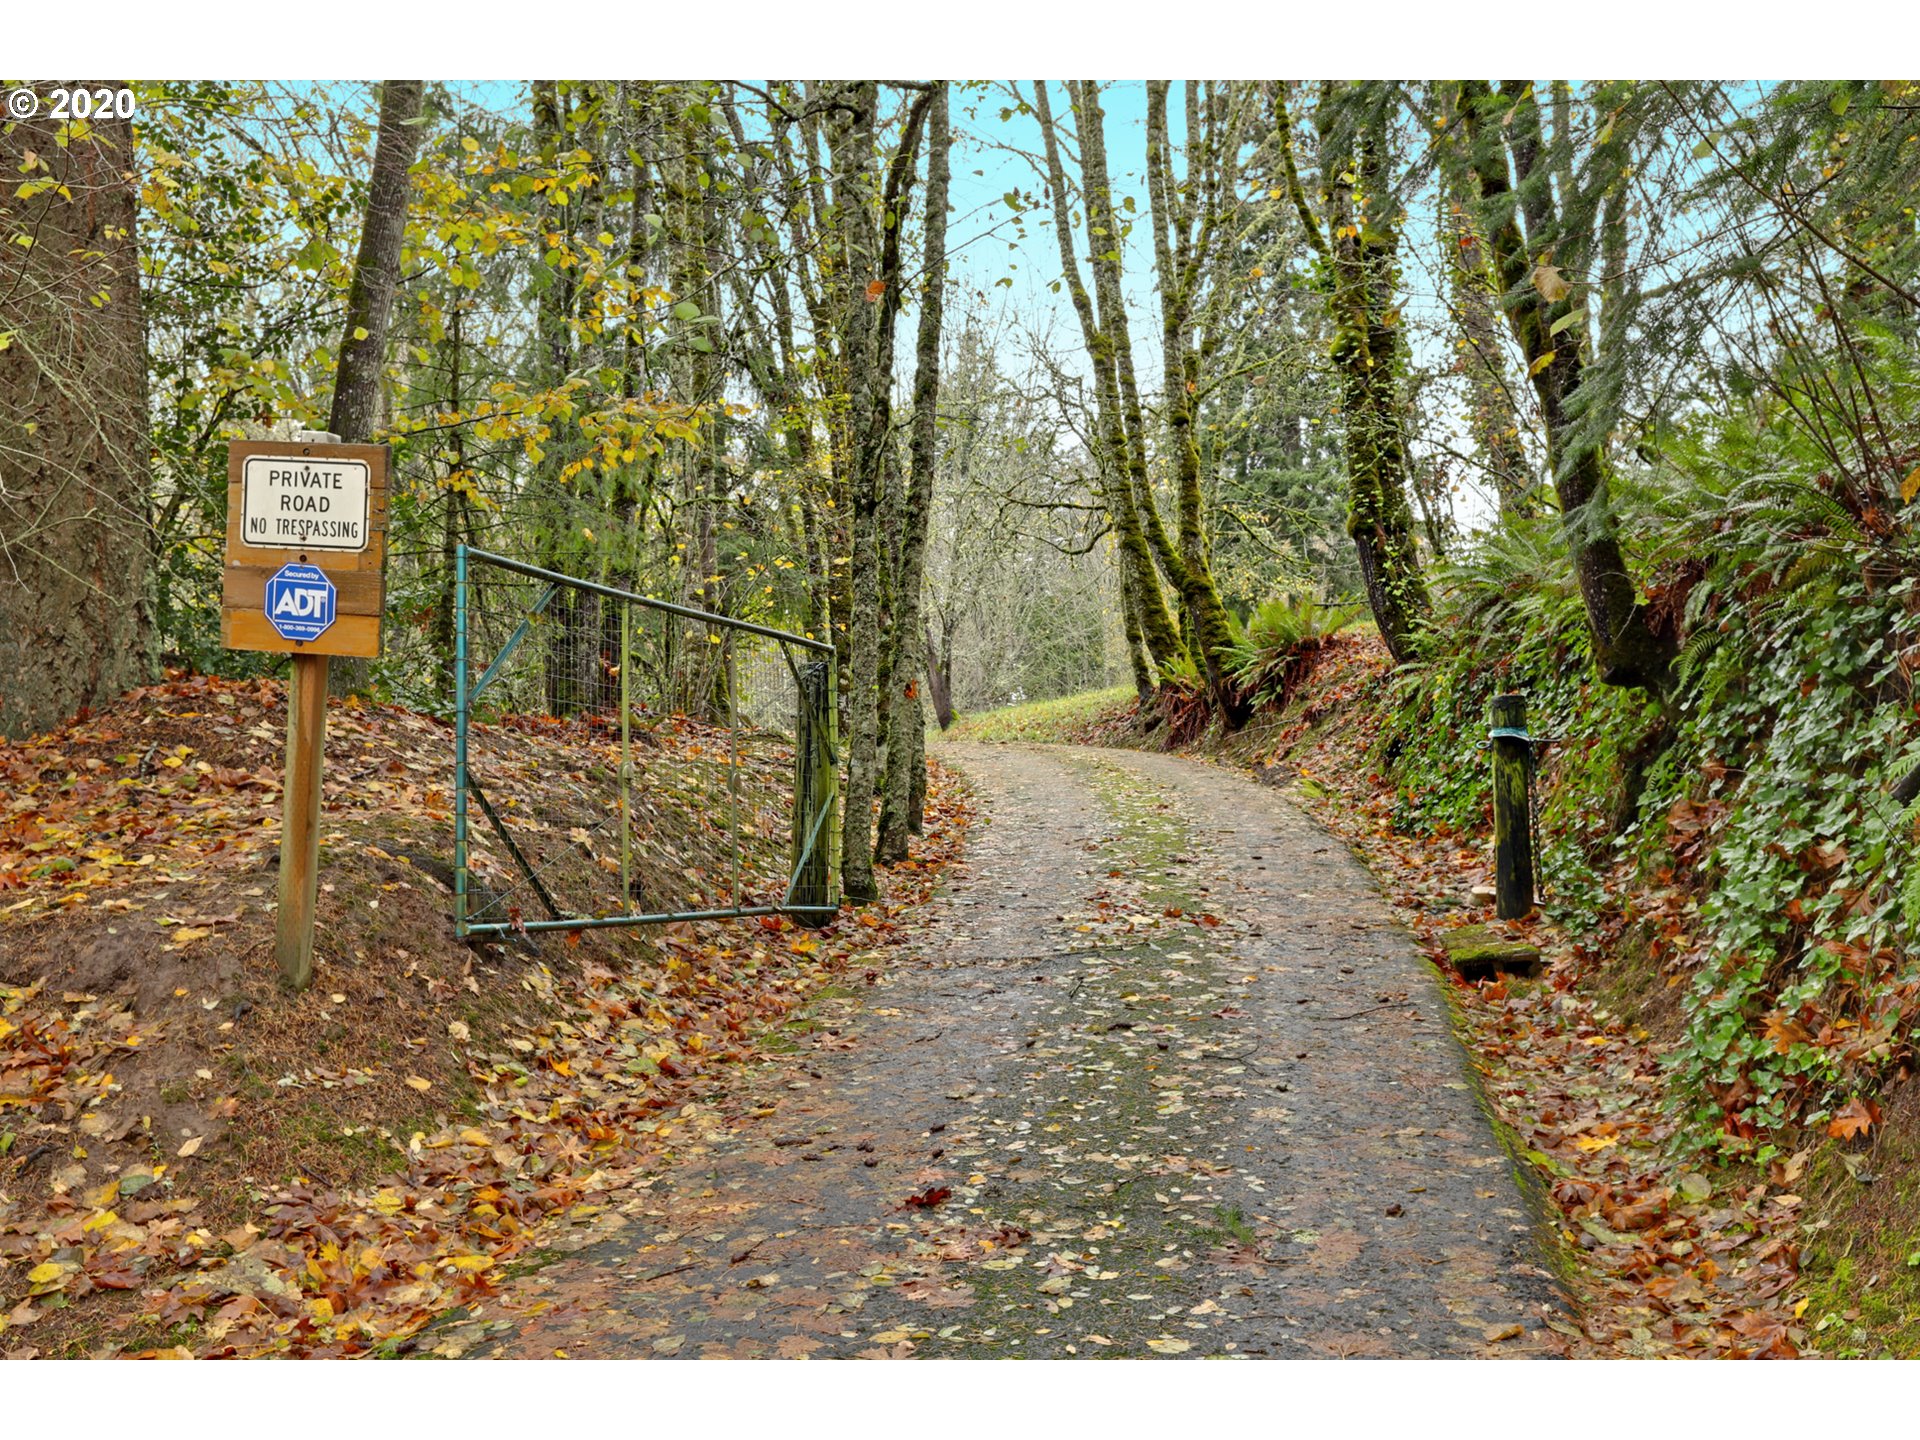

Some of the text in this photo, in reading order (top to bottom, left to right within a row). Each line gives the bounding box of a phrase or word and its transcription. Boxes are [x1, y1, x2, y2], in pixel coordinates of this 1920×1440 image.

[269, 470, 343, 490] PRIVATE
[280, 495, 330, 513] ROAD
[250, 517, 358, 539] NO TRESPASSING
[284, 569, 320, 580] Secured by
[275, 587, 327, 618] ADT
